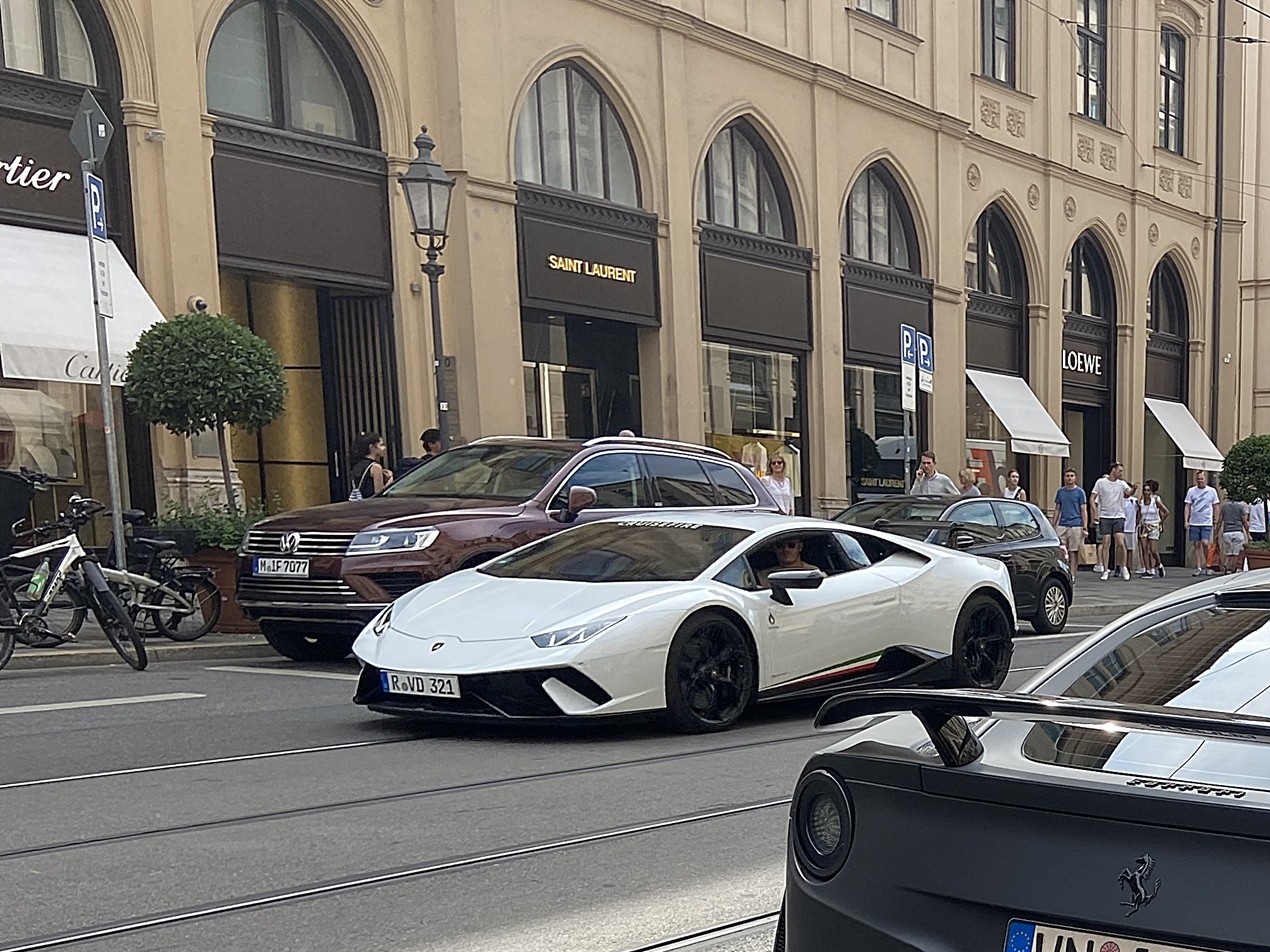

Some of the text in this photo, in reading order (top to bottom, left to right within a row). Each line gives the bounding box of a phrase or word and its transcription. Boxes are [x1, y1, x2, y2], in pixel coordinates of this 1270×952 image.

[90, 183, 101, 229] P
[548, 255, 637, 283] SAINT LAURENT
[903, 330, 912, 358] P
[920, 337, 928, 365] P
[1062, 349, 1102, 375] LOEWE
[860, 477, 878, 487] SAINT
[260, 560, 308, 573] M IF 7077
[391, 675, 455, 695] R VD 321
